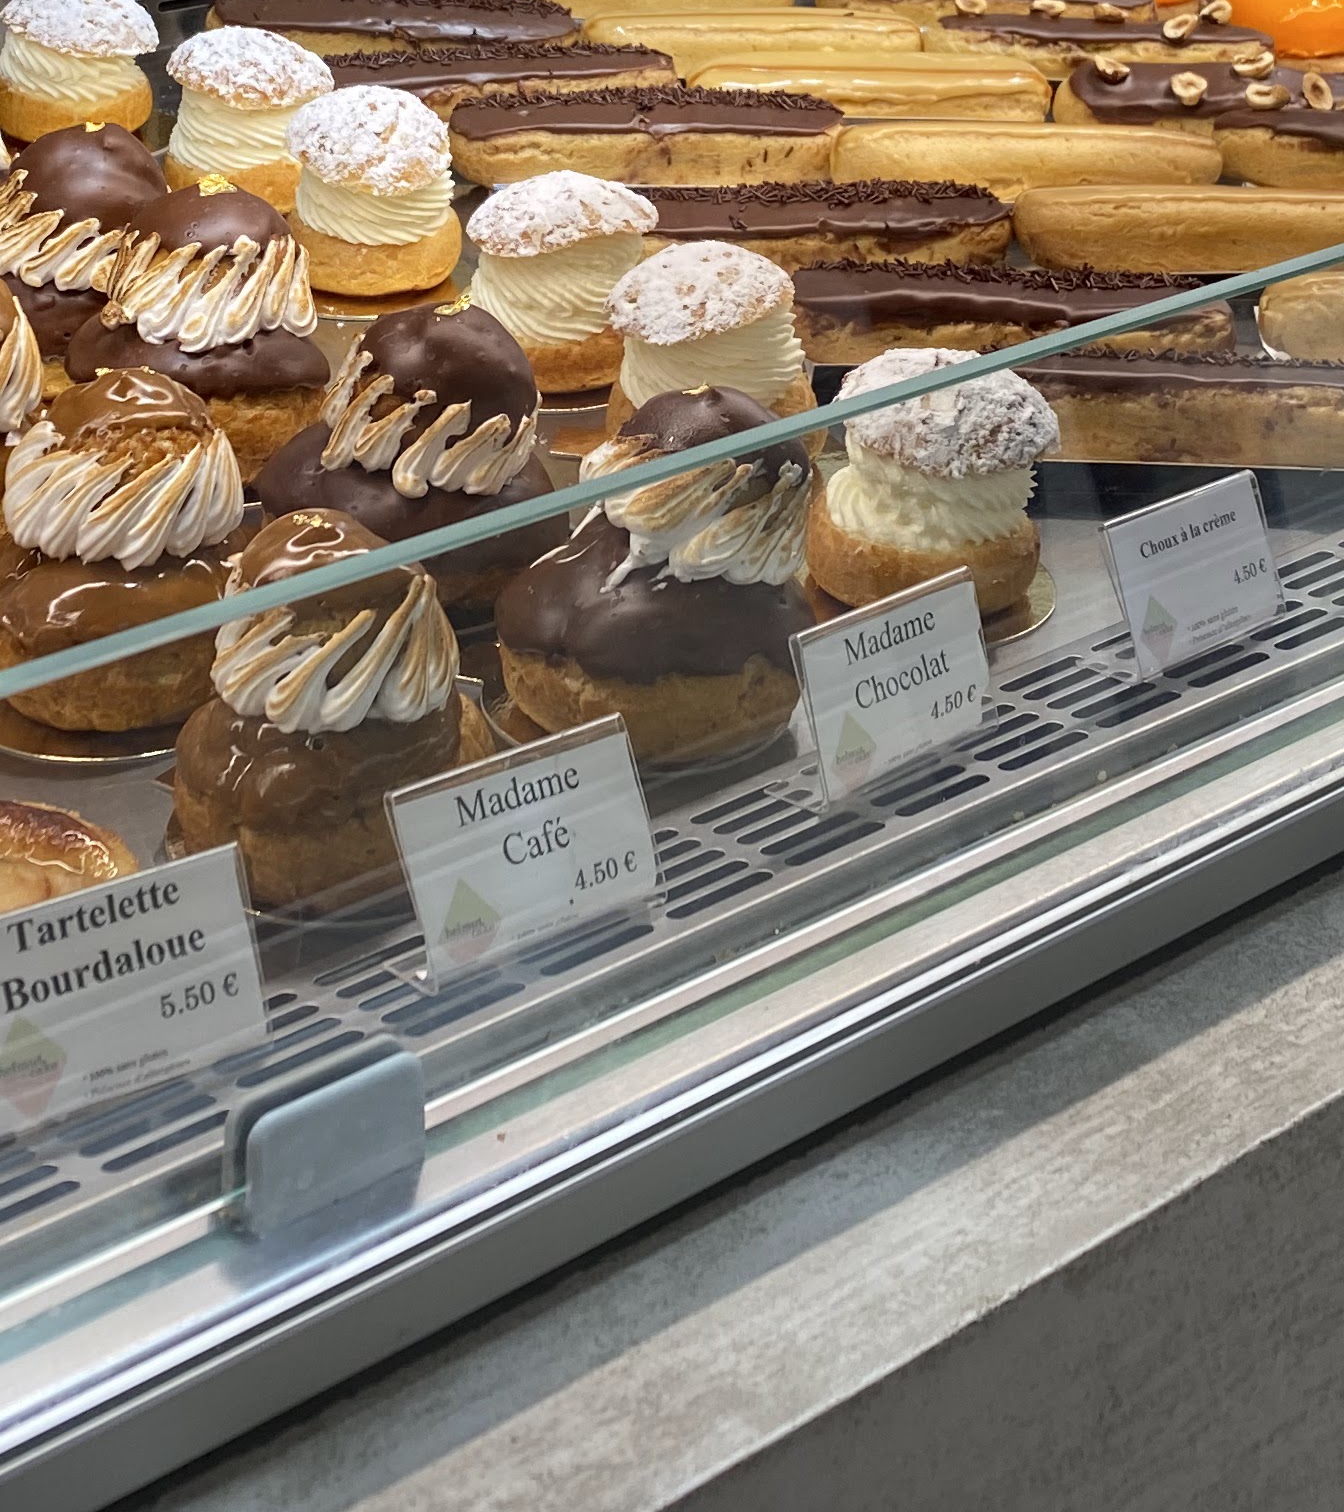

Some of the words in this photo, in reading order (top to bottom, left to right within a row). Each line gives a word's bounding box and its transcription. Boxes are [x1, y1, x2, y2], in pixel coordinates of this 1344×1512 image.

[1139, 534, 1180, 559] Choux
[1180, 526, 1189, 543] à
[1190, 523, 1202, 539] la
[1203, 510, 1237, 533] crème
[1233, 562, 1258, 586] 4.50
[1258, 557, 1268, 574] €
[843, 611, 936, 666] Madame
[855, 649, 951, 709] Chocolat
[930, 690, 963, 720] 4.50
[967, 684, 977, 703] €
[453, 767, 580, 827] Madame
[502, 817, 571, 865] Café
[574, 858, 619, 890] 4.50
[624, 850, 638, 872] €
[7, 881, 182, 953] Tartelette
[1, 927, 207, 1014] Bourdaloue
[160, 981, 216, 1020] 5.50
[223, 972, 240, 998] €
